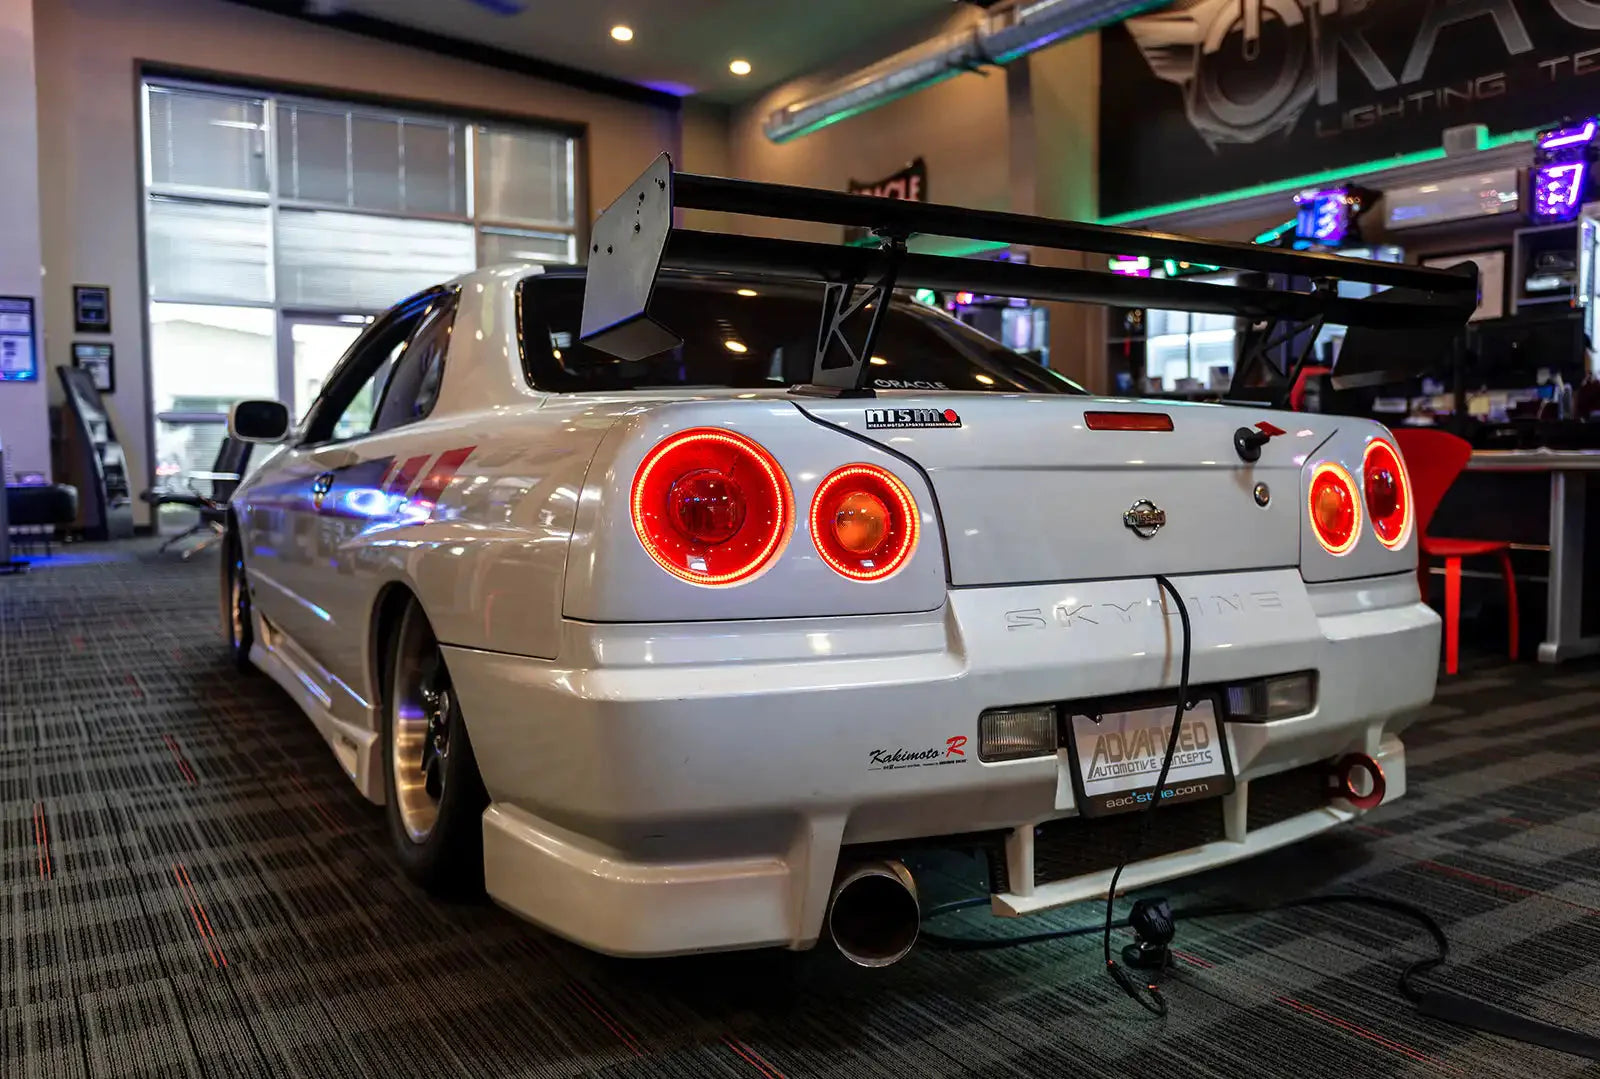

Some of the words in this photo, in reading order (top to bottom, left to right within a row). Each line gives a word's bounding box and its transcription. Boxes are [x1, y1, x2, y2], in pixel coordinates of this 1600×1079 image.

[1200, 0, 1600, 127] ORA
[1315, 71, 1507, 138] LIGHTING
[873, 378, 950, 390] ORACLE
[1004, 590, 1283, 631] SKYLINE
[1087, 721, 1210, 780] ADVANCED
[1093, 758, 1157, 777] AUTOMOTIVE
[1160, 750, 1213, 768] CNCEPTS
